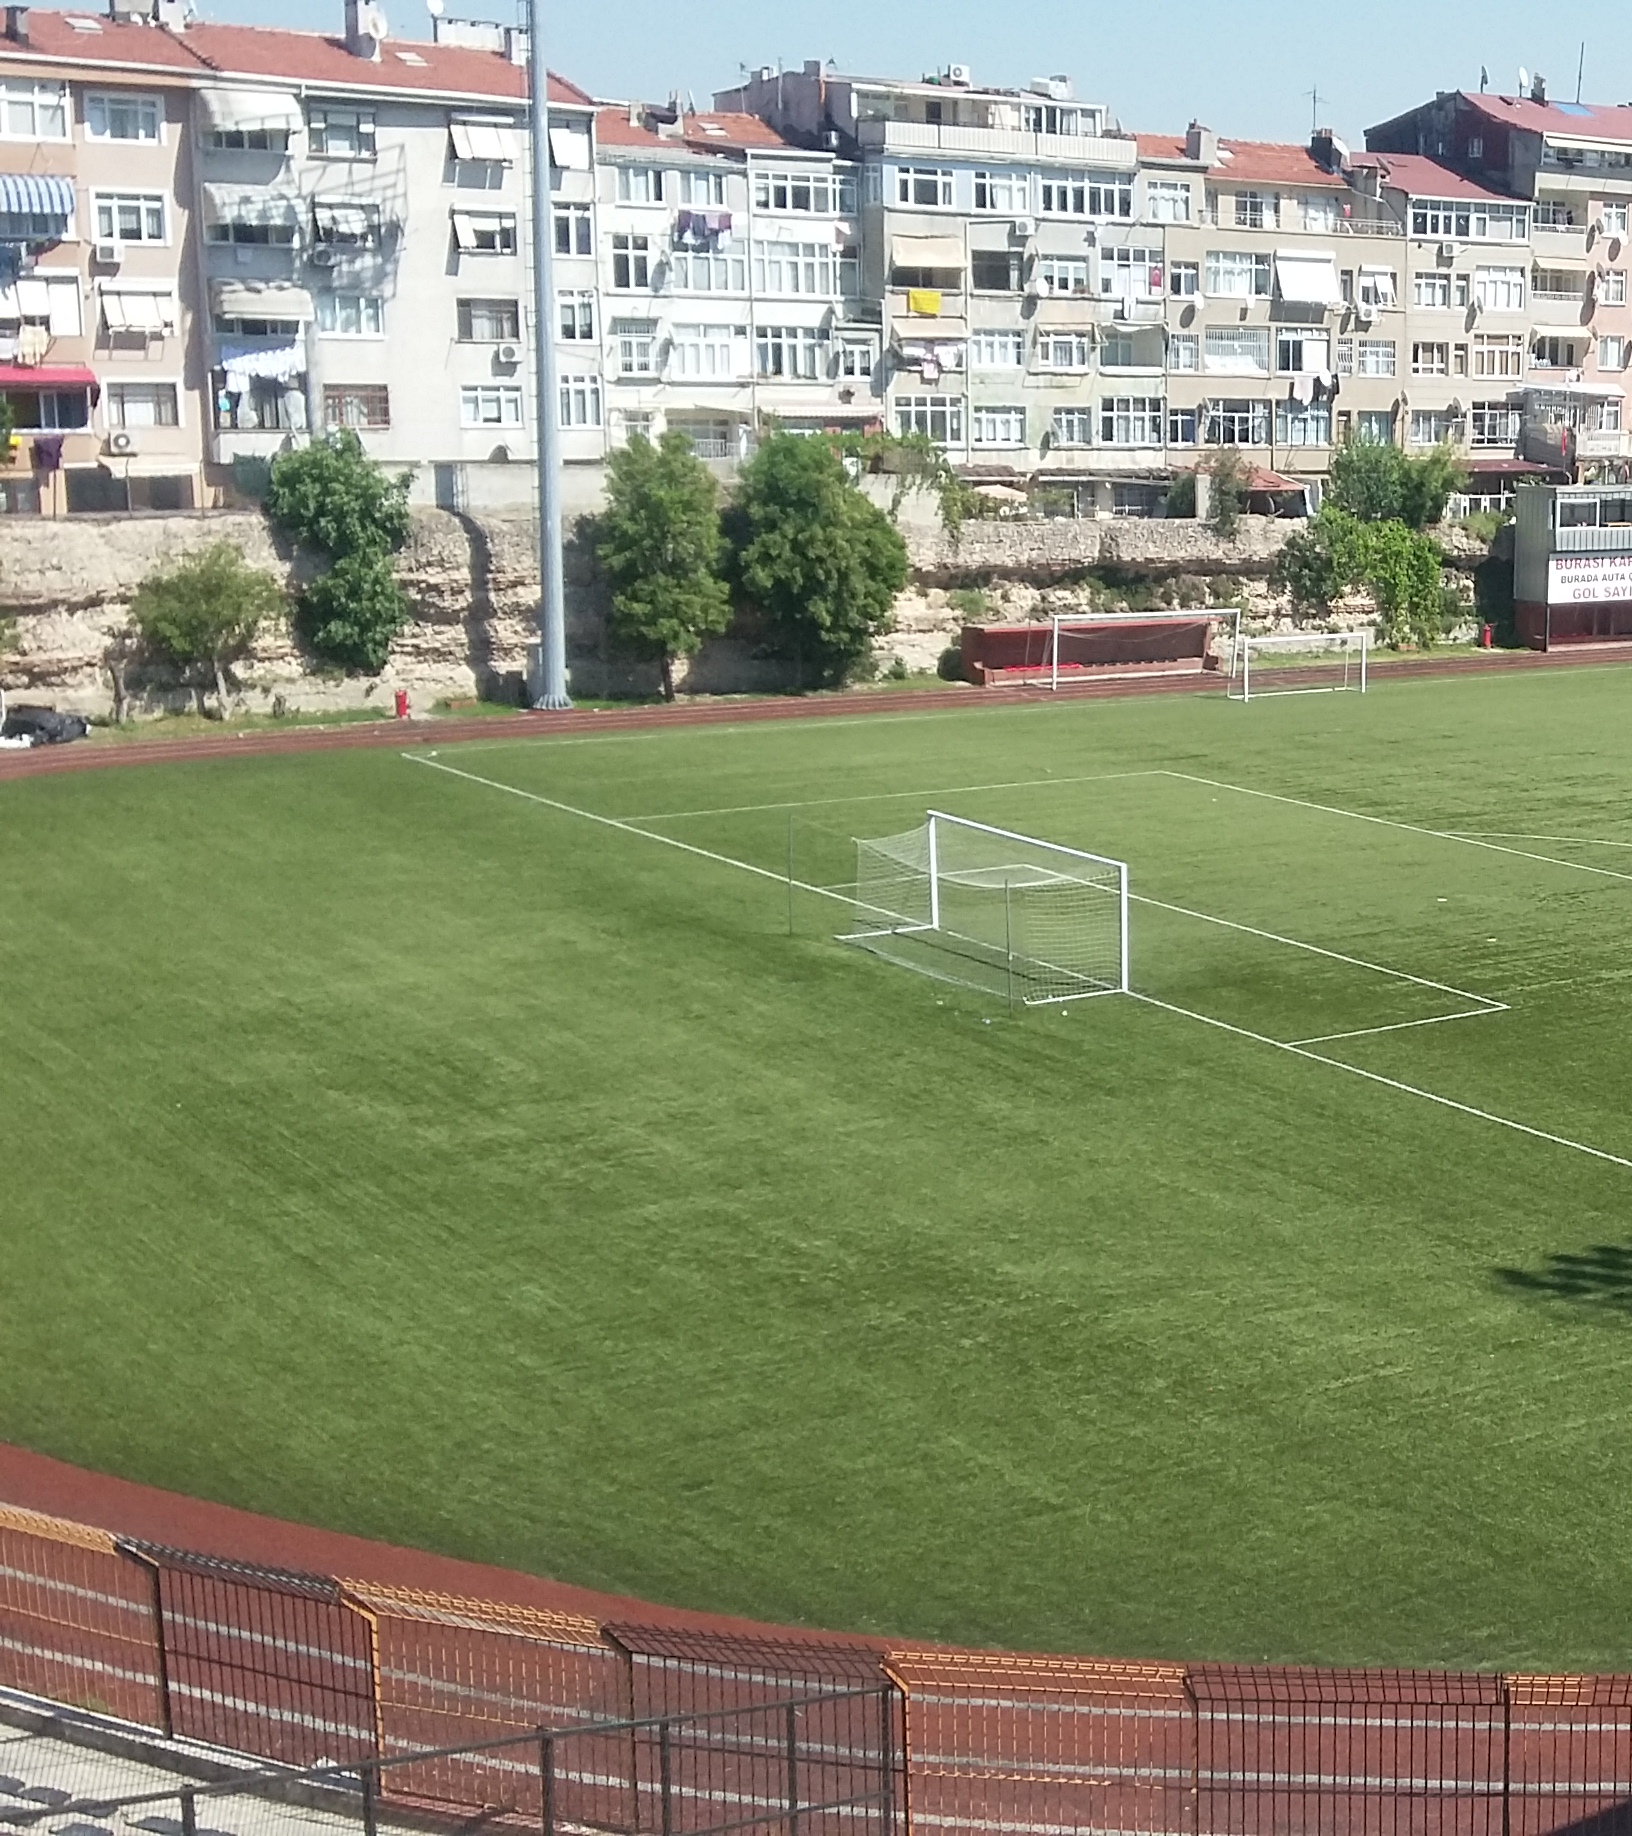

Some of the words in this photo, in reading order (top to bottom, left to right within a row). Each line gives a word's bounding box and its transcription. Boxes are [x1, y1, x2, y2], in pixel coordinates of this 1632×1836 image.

[1555, 556, 1604, 571] BURASI
[1560, 574, 1599, 584] BURADA
[1601, 572, 1626, 582] AUTA
[1572, 587, 1599, 600] GOL
